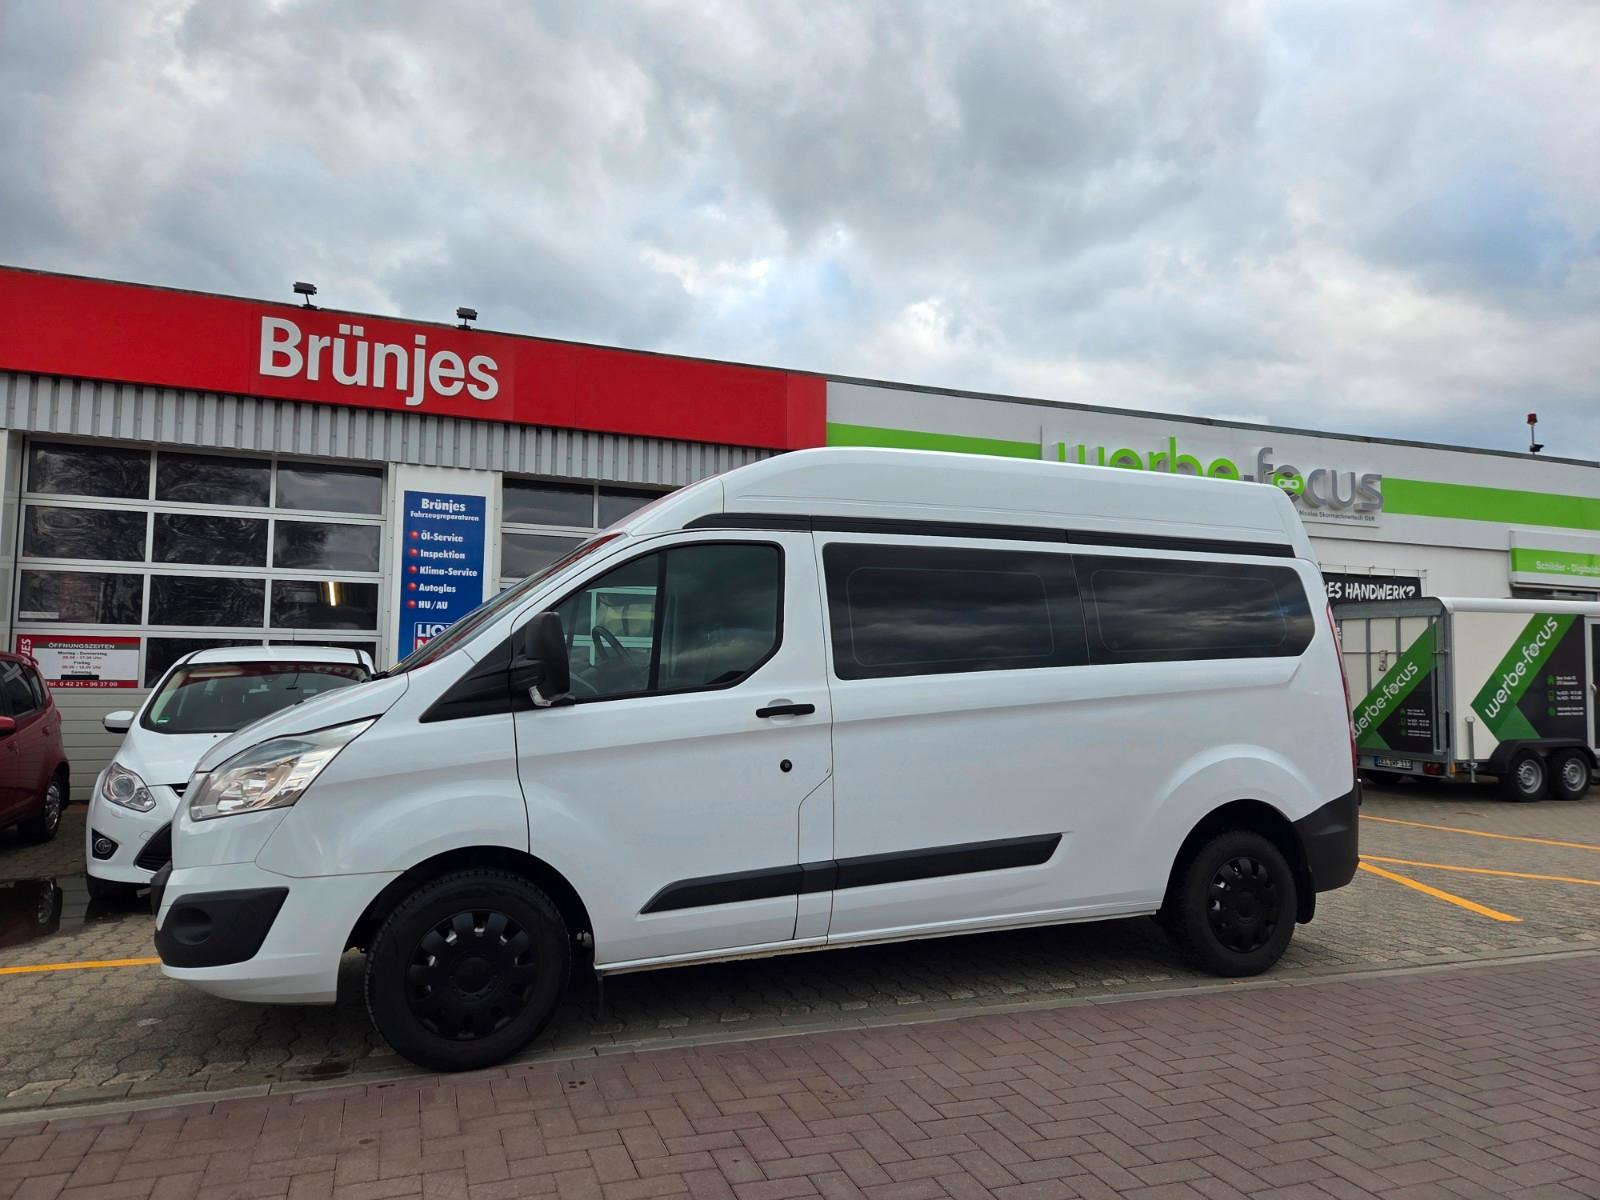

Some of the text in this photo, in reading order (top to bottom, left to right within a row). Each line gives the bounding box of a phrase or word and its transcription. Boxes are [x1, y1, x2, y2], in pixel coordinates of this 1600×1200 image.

[260, 315, 499, 406] Brünjes
[421, 498, 466, 513] Brünjes
[410, 510, 479, 521] Fahrzeugreparaturen
[420, 530, 464, 542] Öl-Service
[420, 549, 466, 560] Inspektion
[419, 566, 478, 577] Klima-Service
[418, 583, 457, 594] Autoglas
[1325, 582, 1416, 601] ES HANDWERK?
[418, 600, 448, 610] HU/AU
[417, 624, 449, 637] LIQ
[1484, 616, 1559, 719] werbe-focus
